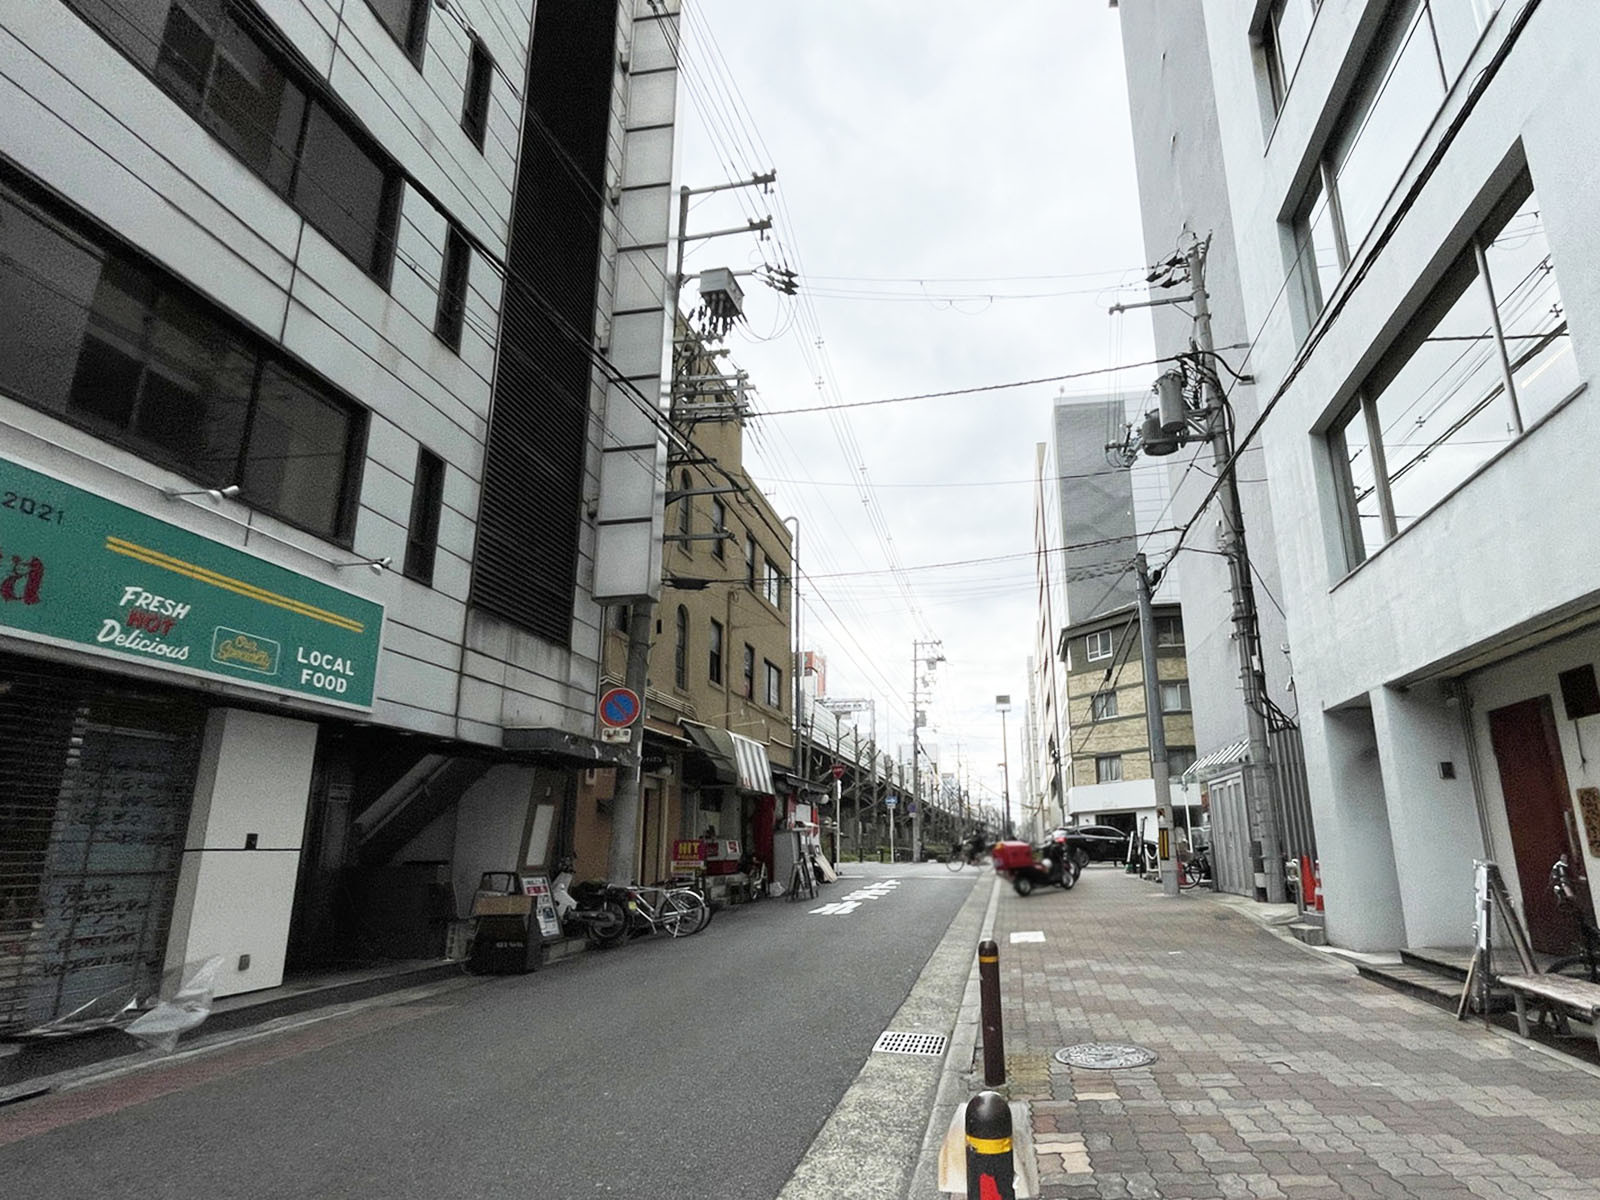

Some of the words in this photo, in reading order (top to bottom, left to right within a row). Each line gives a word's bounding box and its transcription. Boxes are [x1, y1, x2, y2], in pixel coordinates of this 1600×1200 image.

[1, 491, 65, 525] 2021
[119, 586, 191, 619] FRESH
[126, 609, 177, 636] HOT
[97, 618, 190, 660] Delicious
[297, 647, 354, 676] LOCAL
[301, 669, 347, 693] FOOD
[678, 841, 701, 854] HIT
